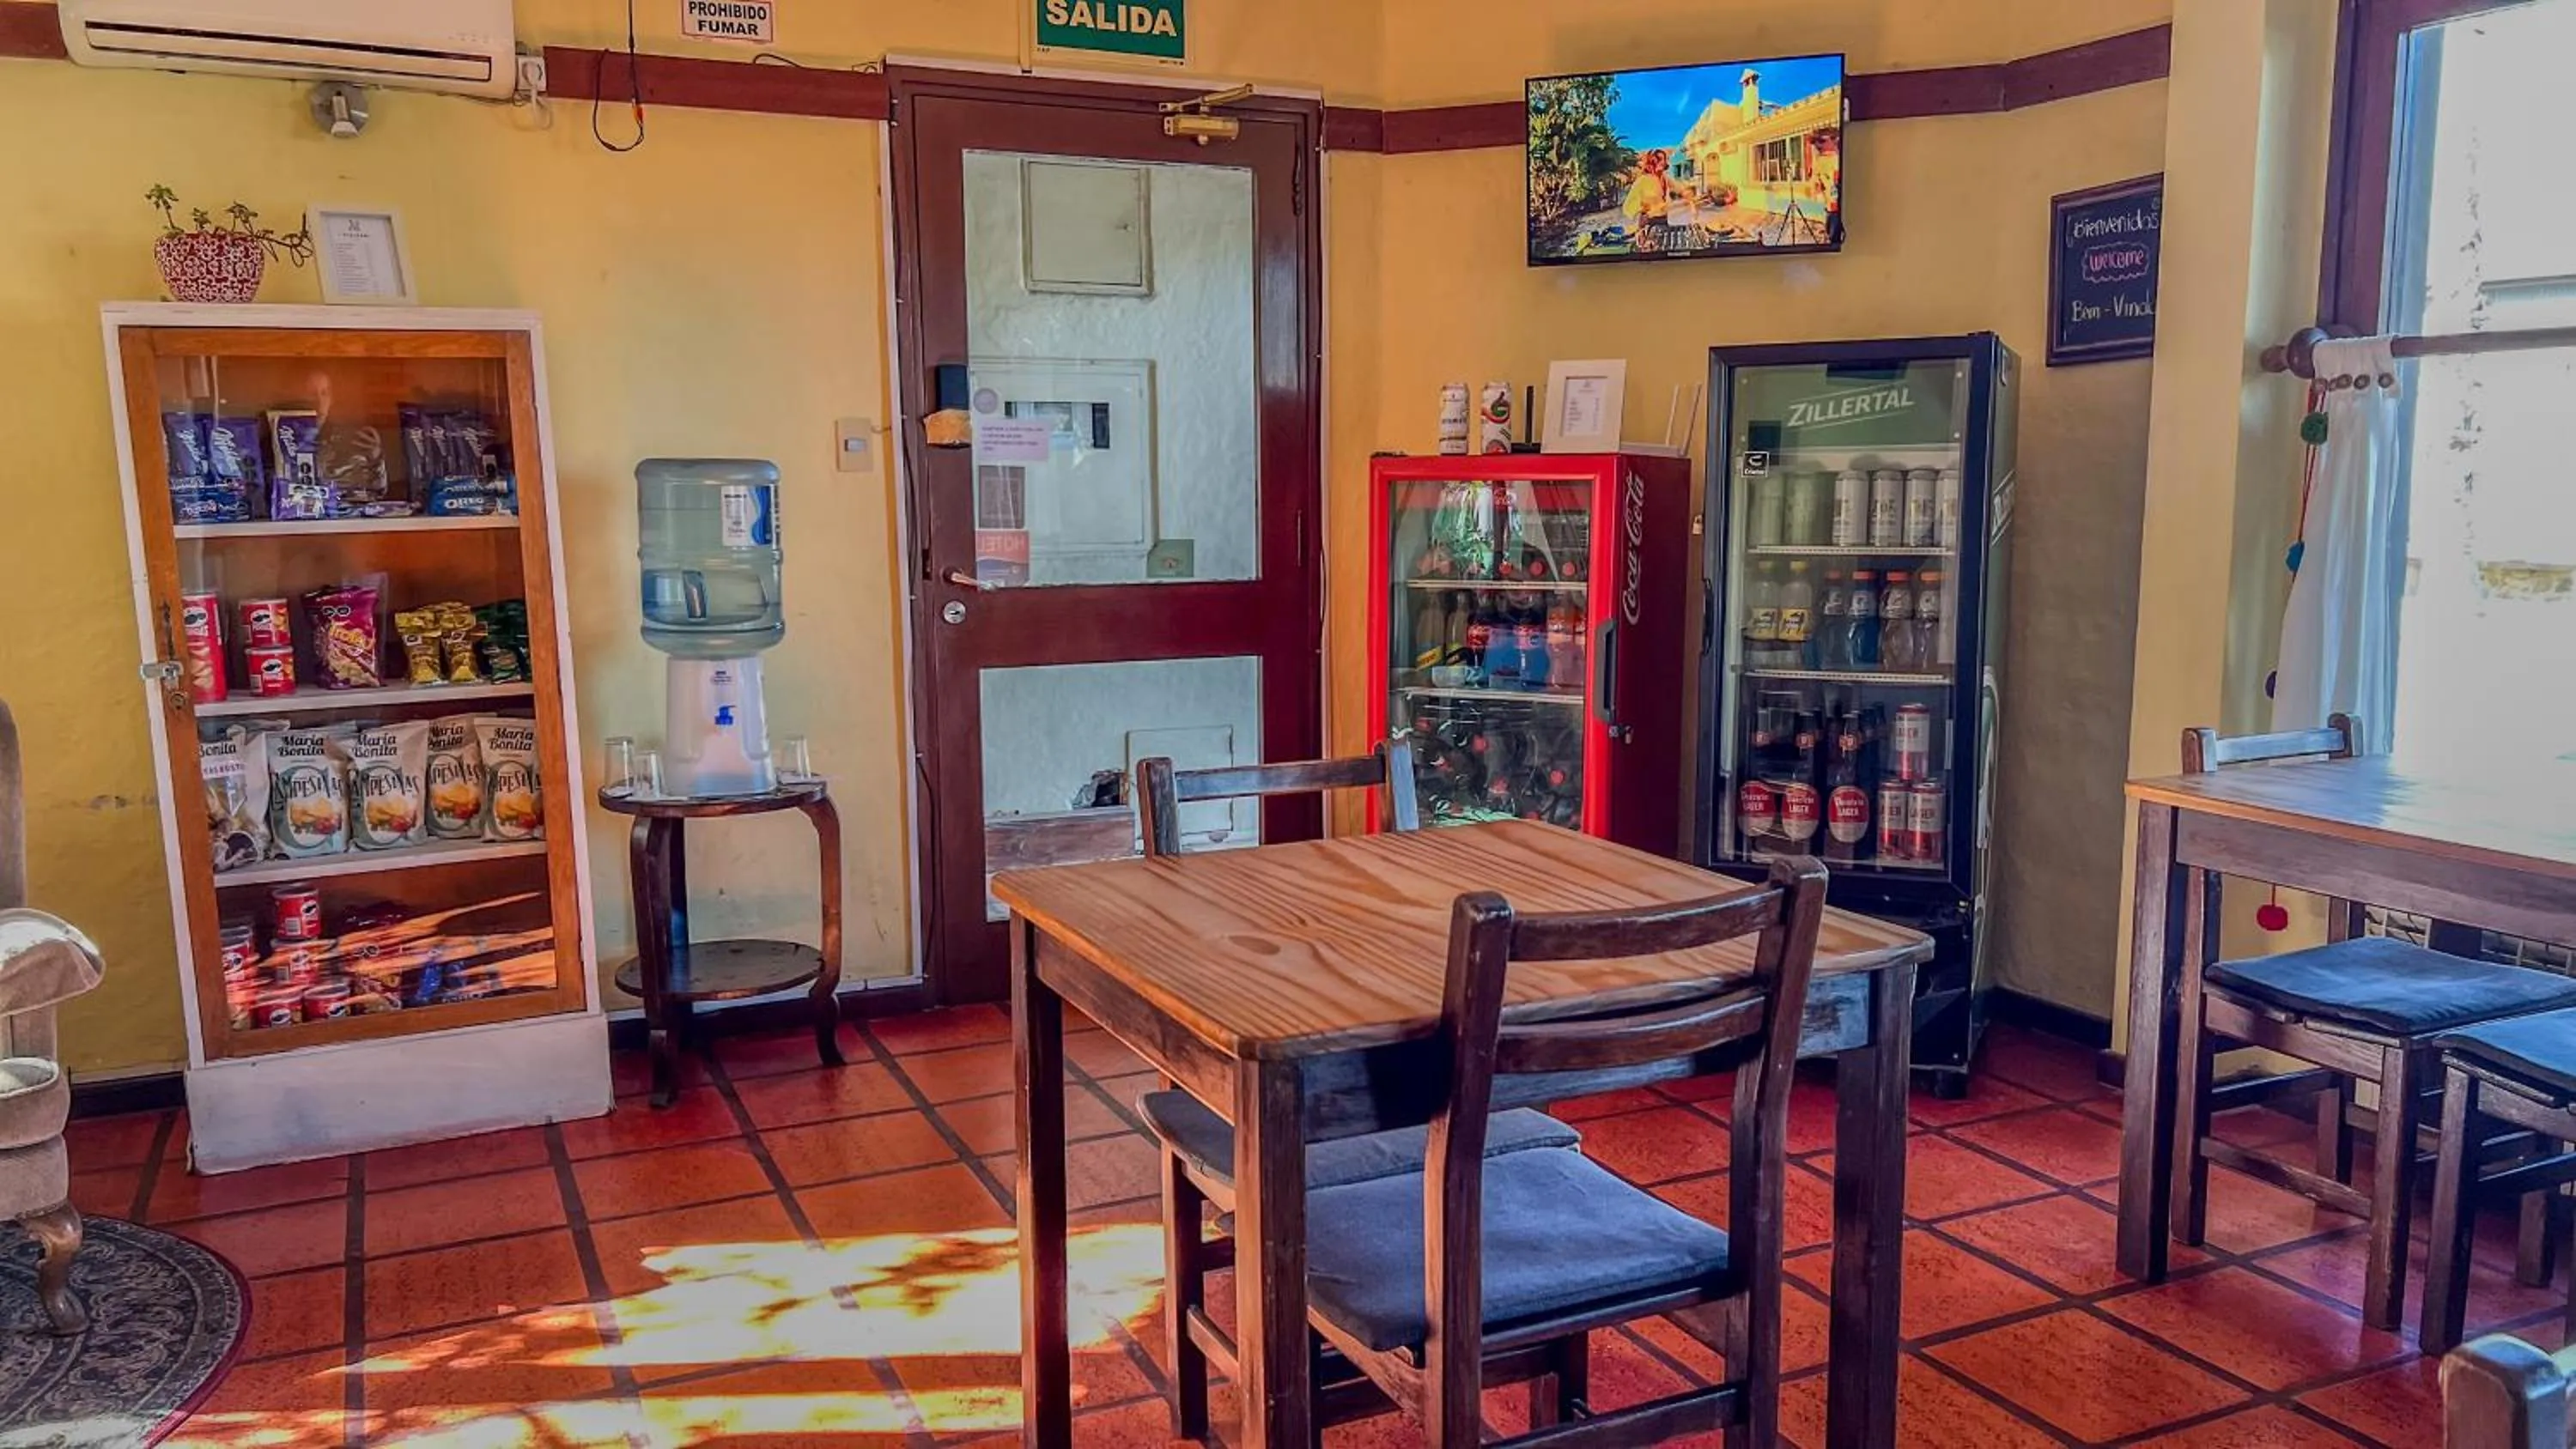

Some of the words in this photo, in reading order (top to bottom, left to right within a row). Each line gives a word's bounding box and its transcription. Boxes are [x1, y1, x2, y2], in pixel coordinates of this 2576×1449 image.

[689, 1, 767, 21] PROHIBIDO
[1046, 0, 1177, 37] SALIDA
[698, 19, 758, 36] FUMAR
[1787, 388, 1916, 427] ZILLERTAL
[277, 746, 325, 757] Bonita
[489, 738, 532, 751] Bonita
